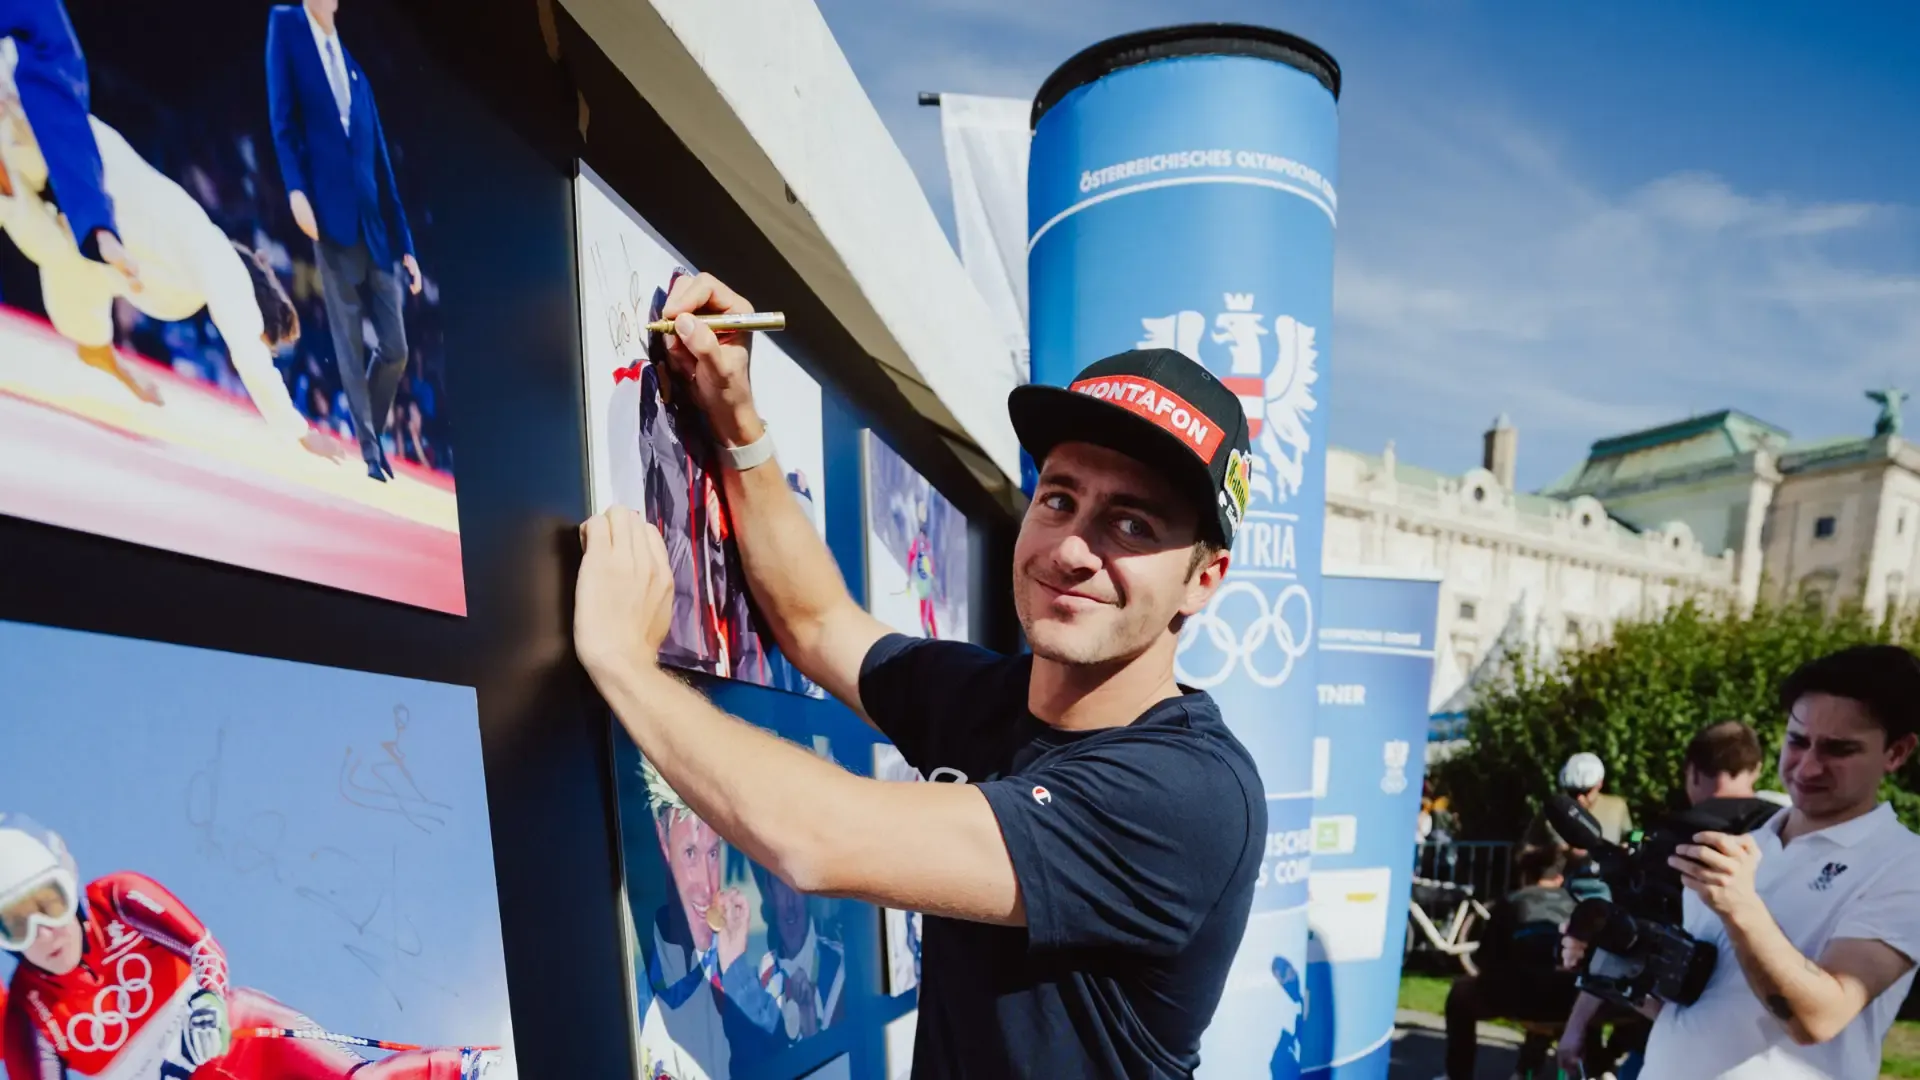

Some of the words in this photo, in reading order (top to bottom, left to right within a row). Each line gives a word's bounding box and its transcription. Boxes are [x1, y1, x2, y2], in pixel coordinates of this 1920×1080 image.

[1080, 149, 1232, 192] ÖSTERREICHISCHES
[1233, 521, 1297, 569] TRIA
[1316, 684, 1366, 705] TNER
